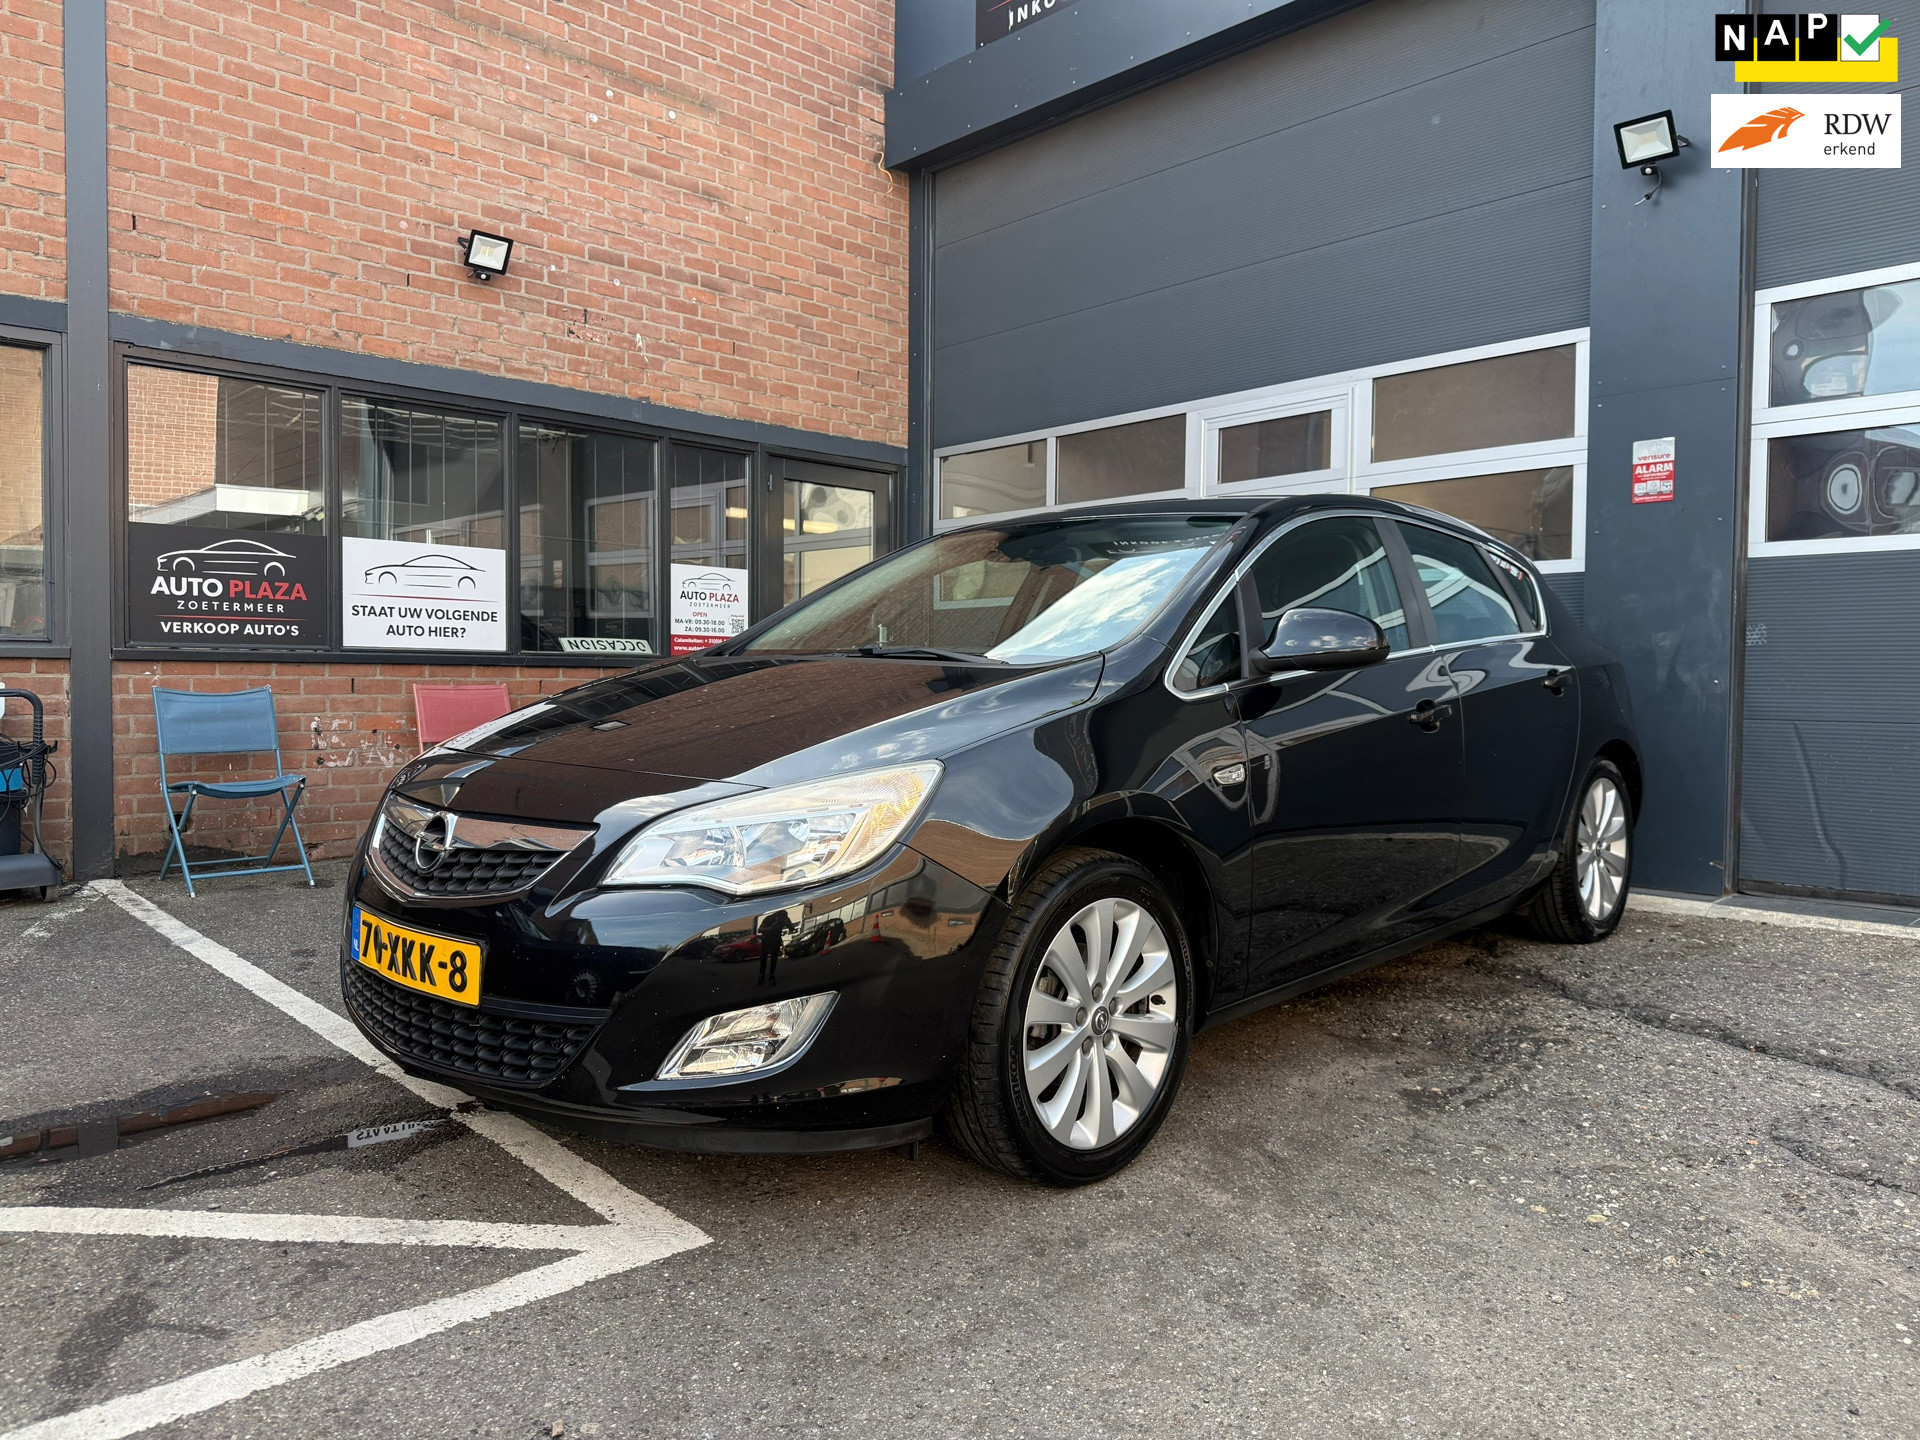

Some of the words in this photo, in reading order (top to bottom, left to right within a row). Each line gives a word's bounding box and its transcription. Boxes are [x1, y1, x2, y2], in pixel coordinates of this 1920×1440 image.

[1638, 453, 1671, 461] verisure
[1635, 462, 1673, 475] ALARM
[151, 576, 223, 597] AUTO
[229, 579, 307, 601] PLAZA
[680, 591, 707, 601] AUTO
[709, 592, 740, 603] PLAZA
[177, 600, 285, 613] ZOETERMEER
[352, 605, 396, 618] STAAT
[398, 607, 422, 619] UW
[425, 608, 498, 622] VOLGENDE
[160, 621, 239, 635] VERKOOP
[244, 623, 299, 636] AUTO'S
[386, 624, 425, 637] AUTO
[428, 626, 467, 638] HIER?
[567, 639, 646, 651] OCCASION
